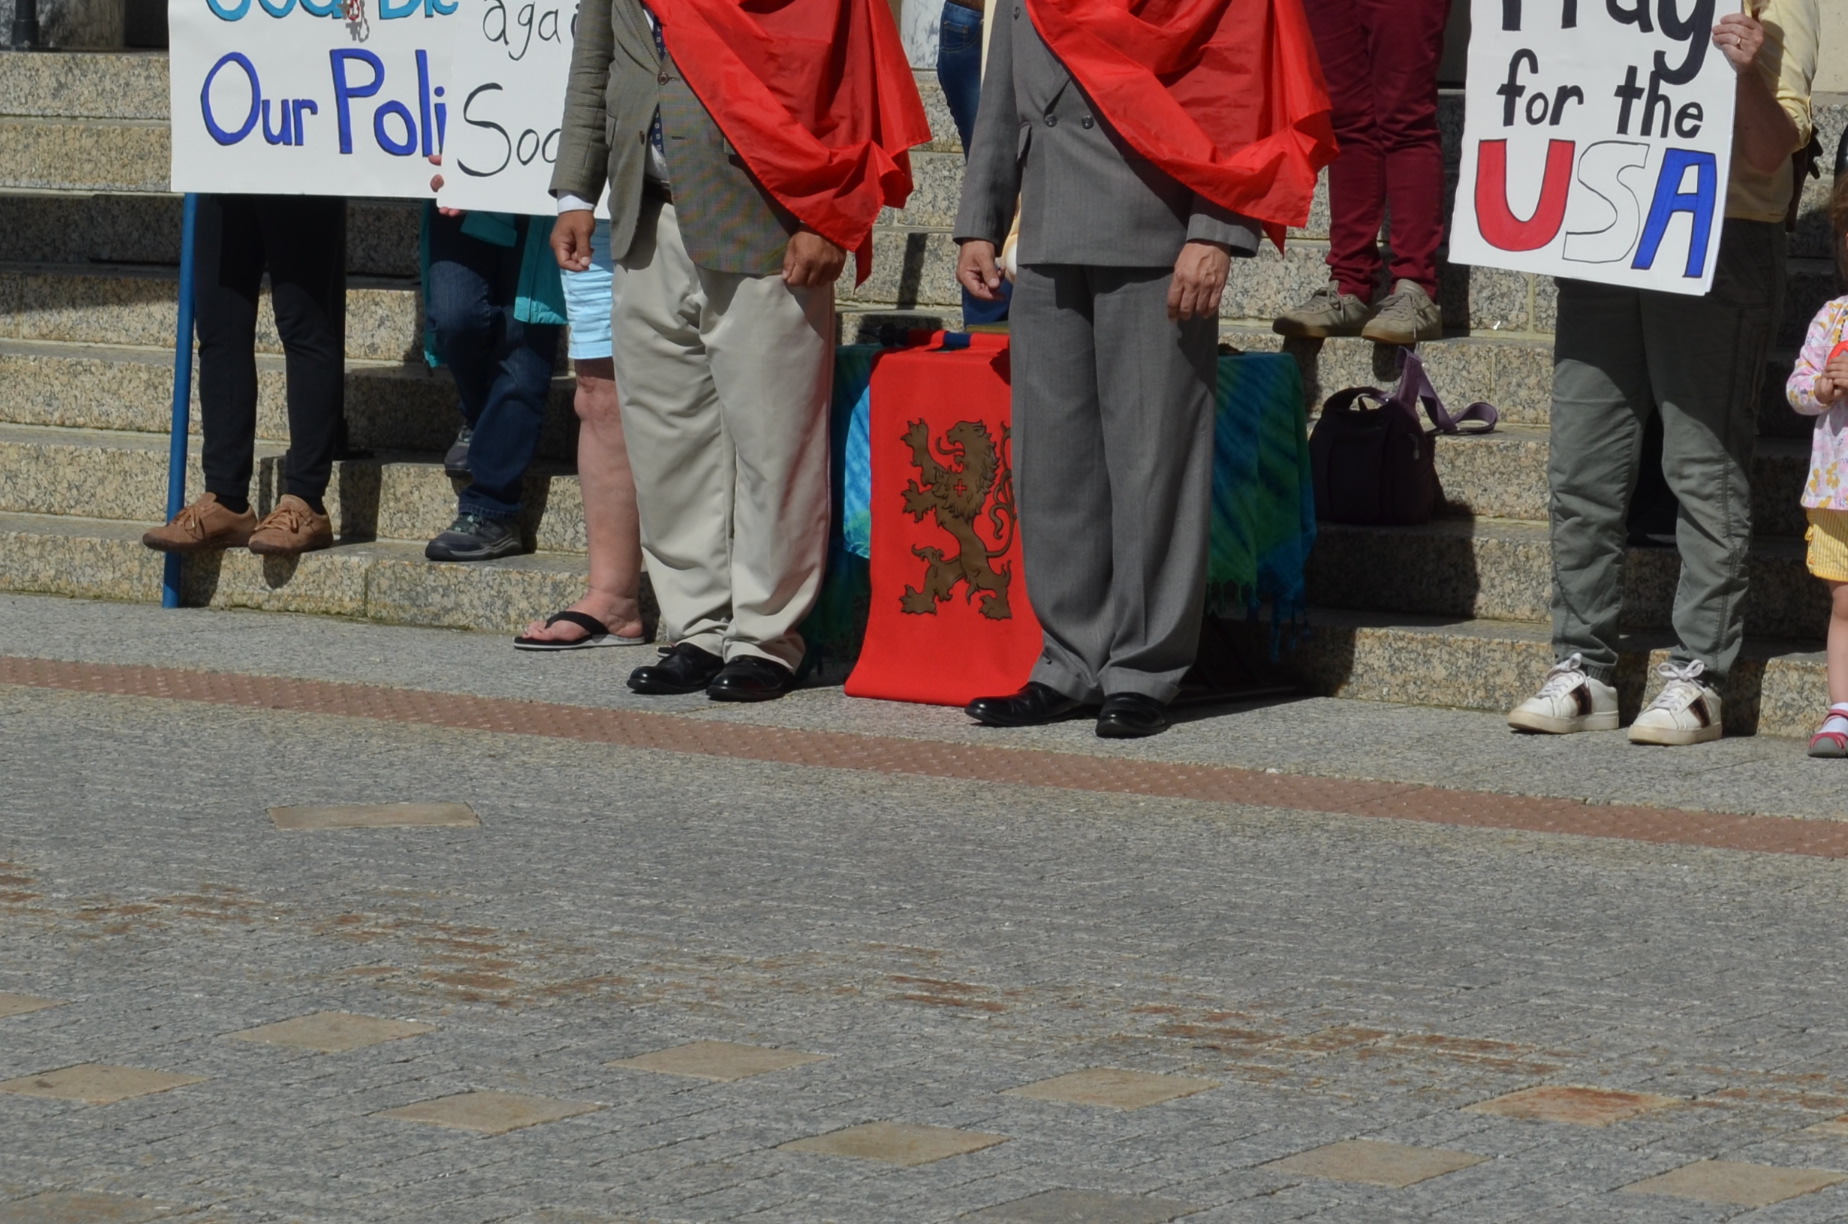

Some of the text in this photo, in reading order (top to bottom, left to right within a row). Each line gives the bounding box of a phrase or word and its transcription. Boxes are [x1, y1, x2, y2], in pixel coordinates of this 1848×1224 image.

[200, 51, 318, 147] Our
[1496, 48, 1704, 138] for the
[1474, 139, 1718, 278] USA
